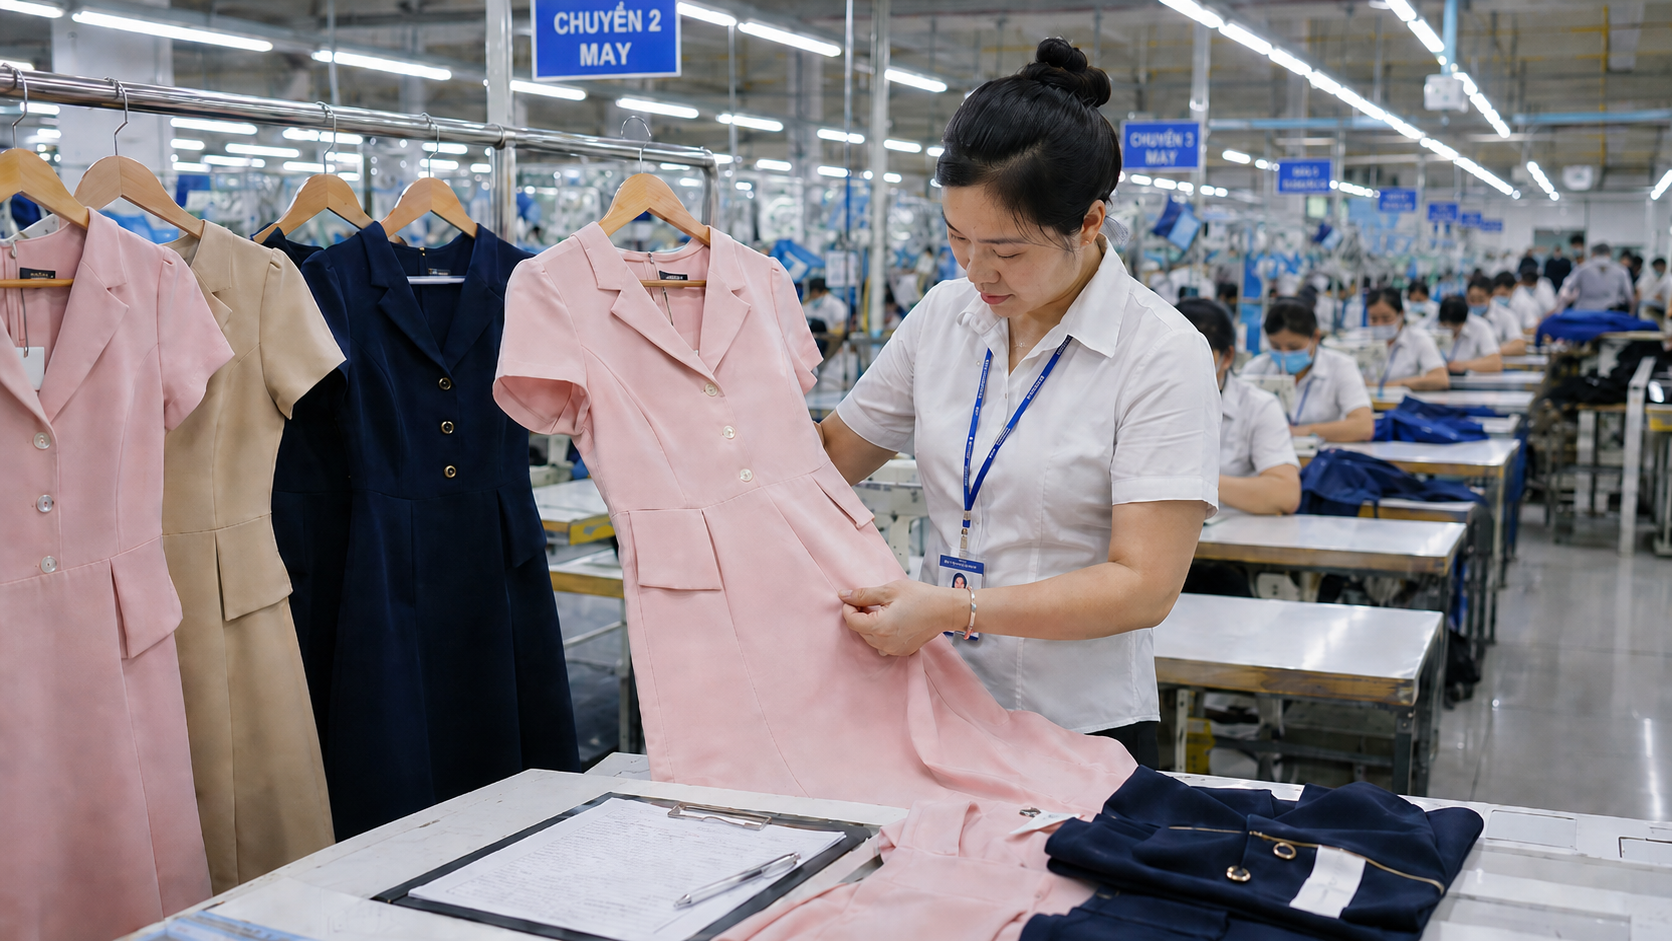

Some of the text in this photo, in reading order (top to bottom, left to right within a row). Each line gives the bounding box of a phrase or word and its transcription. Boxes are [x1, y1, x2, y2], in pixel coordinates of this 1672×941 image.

[648, 9, 661, 32] 2
[580, 42, 632, 66] MAY
[1145, 149, 1178, 166] MAY
